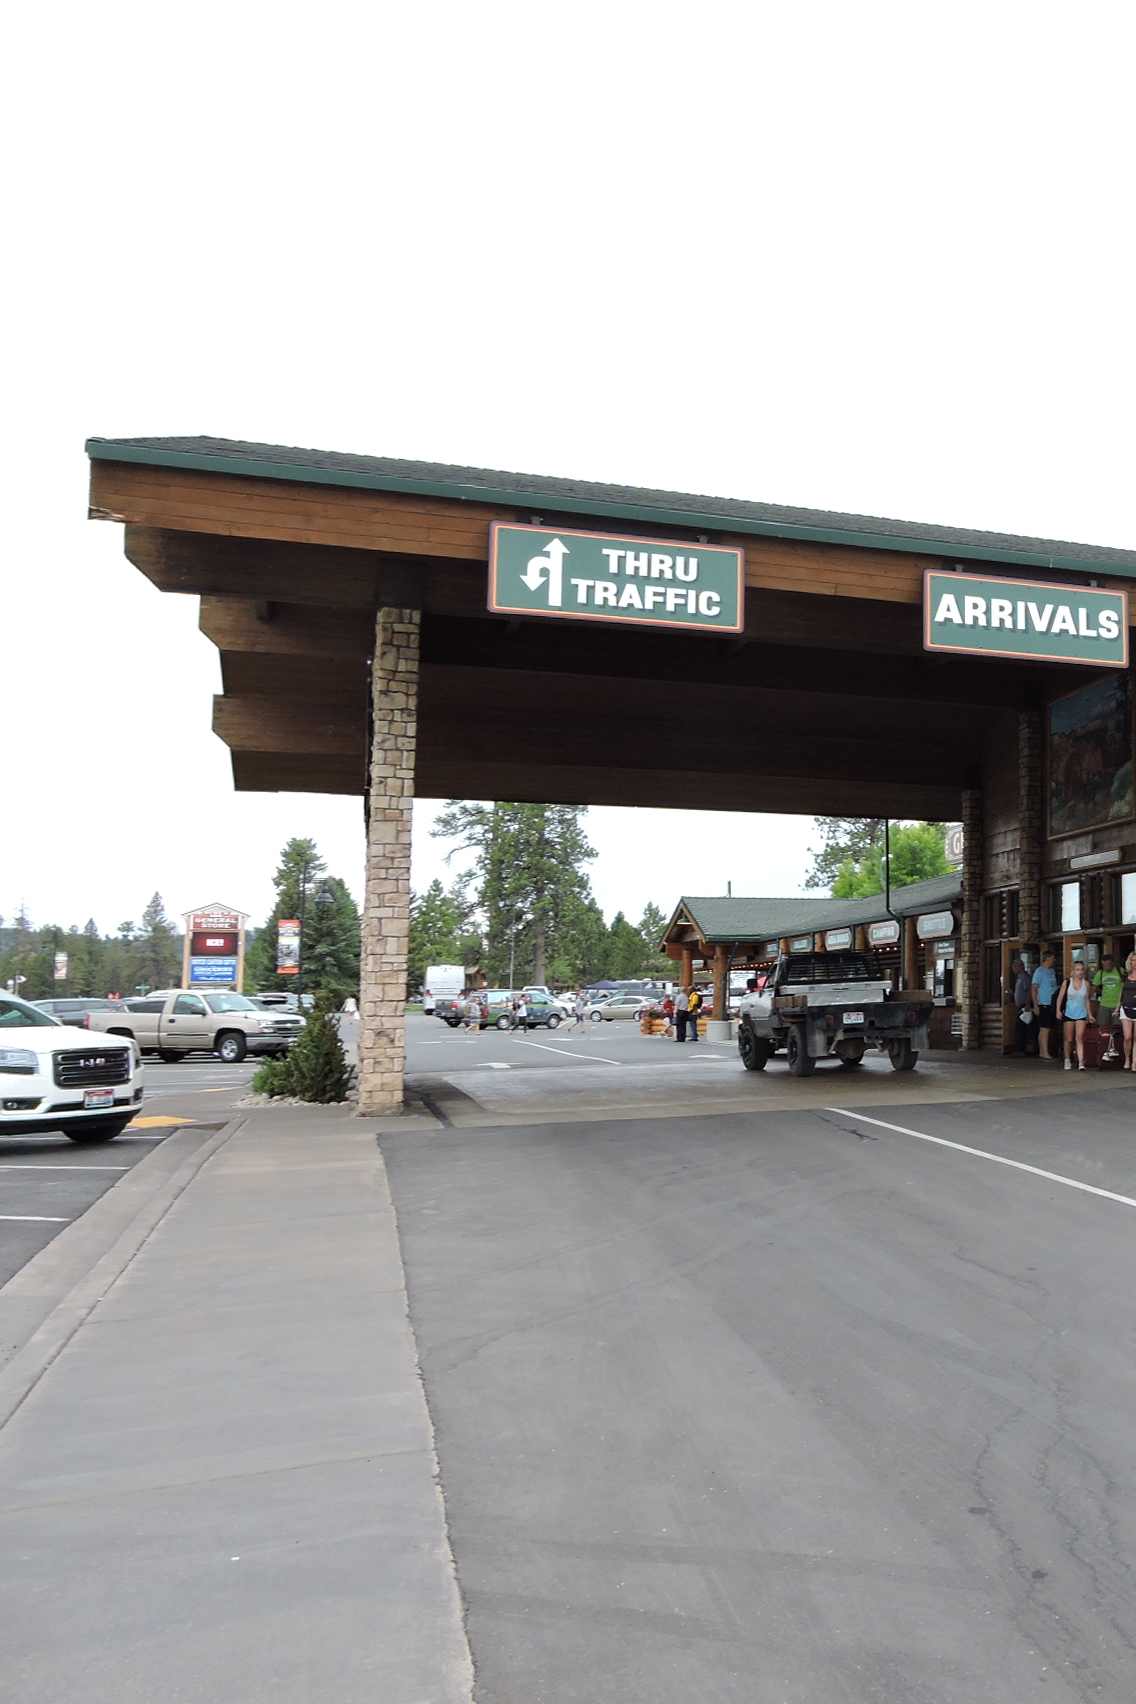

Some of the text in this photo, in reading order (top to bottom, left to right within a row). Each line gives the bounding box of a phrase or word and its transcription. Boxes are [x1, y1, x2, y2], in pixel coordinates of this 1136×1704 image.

[602, 548, 698, 582] THRU
[570, 578, 721, 617] TRAFFIC
[934, 593, 1120, 640] ARRIVALS
